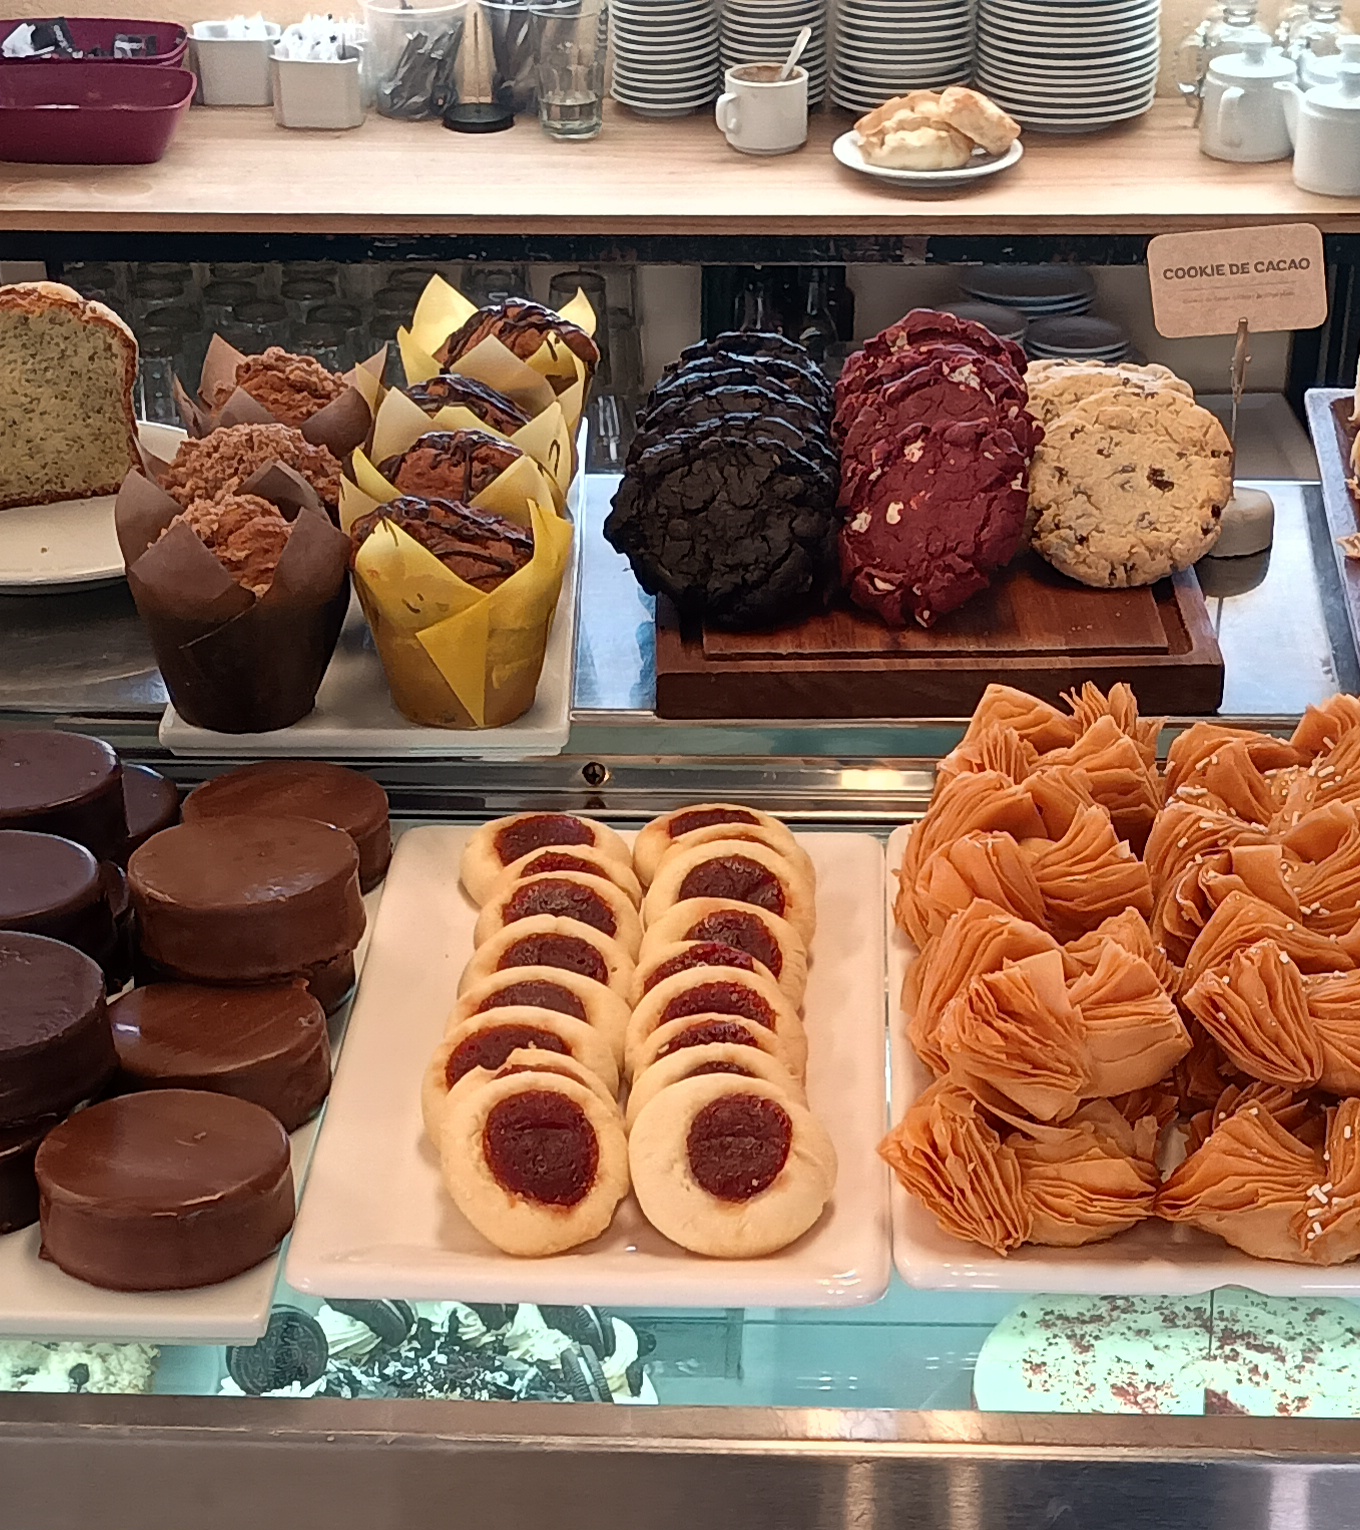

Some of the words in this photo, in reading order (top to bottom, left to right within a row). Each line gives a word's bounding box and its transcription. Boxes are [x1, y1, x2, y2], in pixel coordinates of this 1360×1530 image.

[1162, 263, 1227, 280] COOKIE
[1229, 261, 1250, 275] DE
[1254, 257, 1311, 273] CACAO
